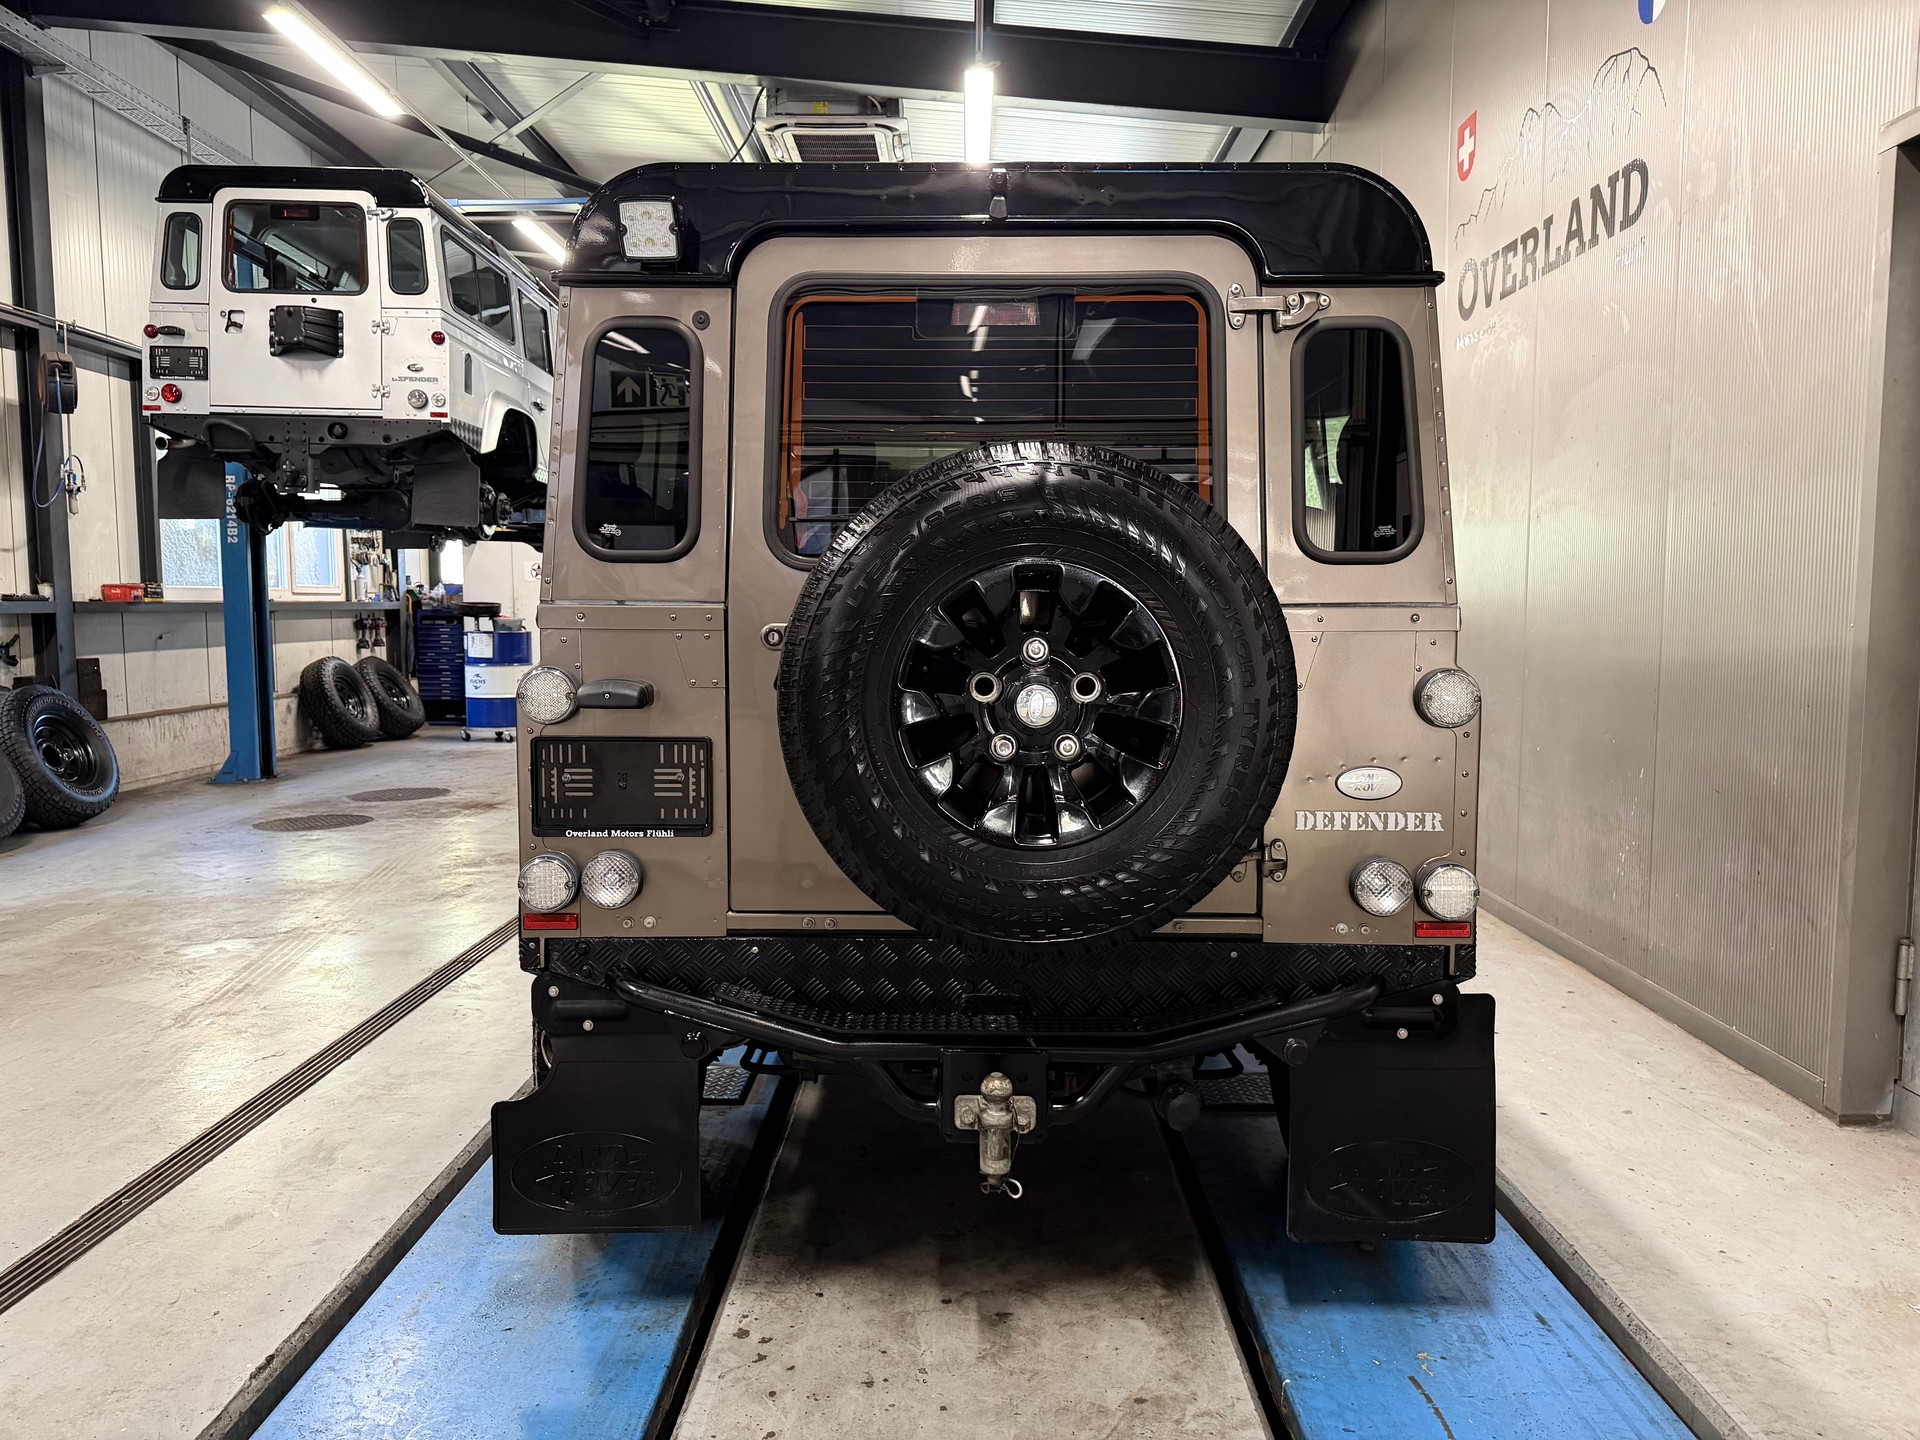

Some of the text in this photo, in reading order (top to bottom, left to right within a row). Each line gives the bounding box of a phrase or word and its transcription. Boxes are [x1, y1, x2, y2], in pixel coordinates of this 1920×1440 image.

[1457, 157, 1649, 321] OVERLAND
[845, 484, 1019, 608] LT235/85R16
[1194, 560, 1261, 808] nokian TYRES
[565, 829, 675, 838] Overland Motors Flühli
[1294, 810, 1445, 832] DEFENDER
